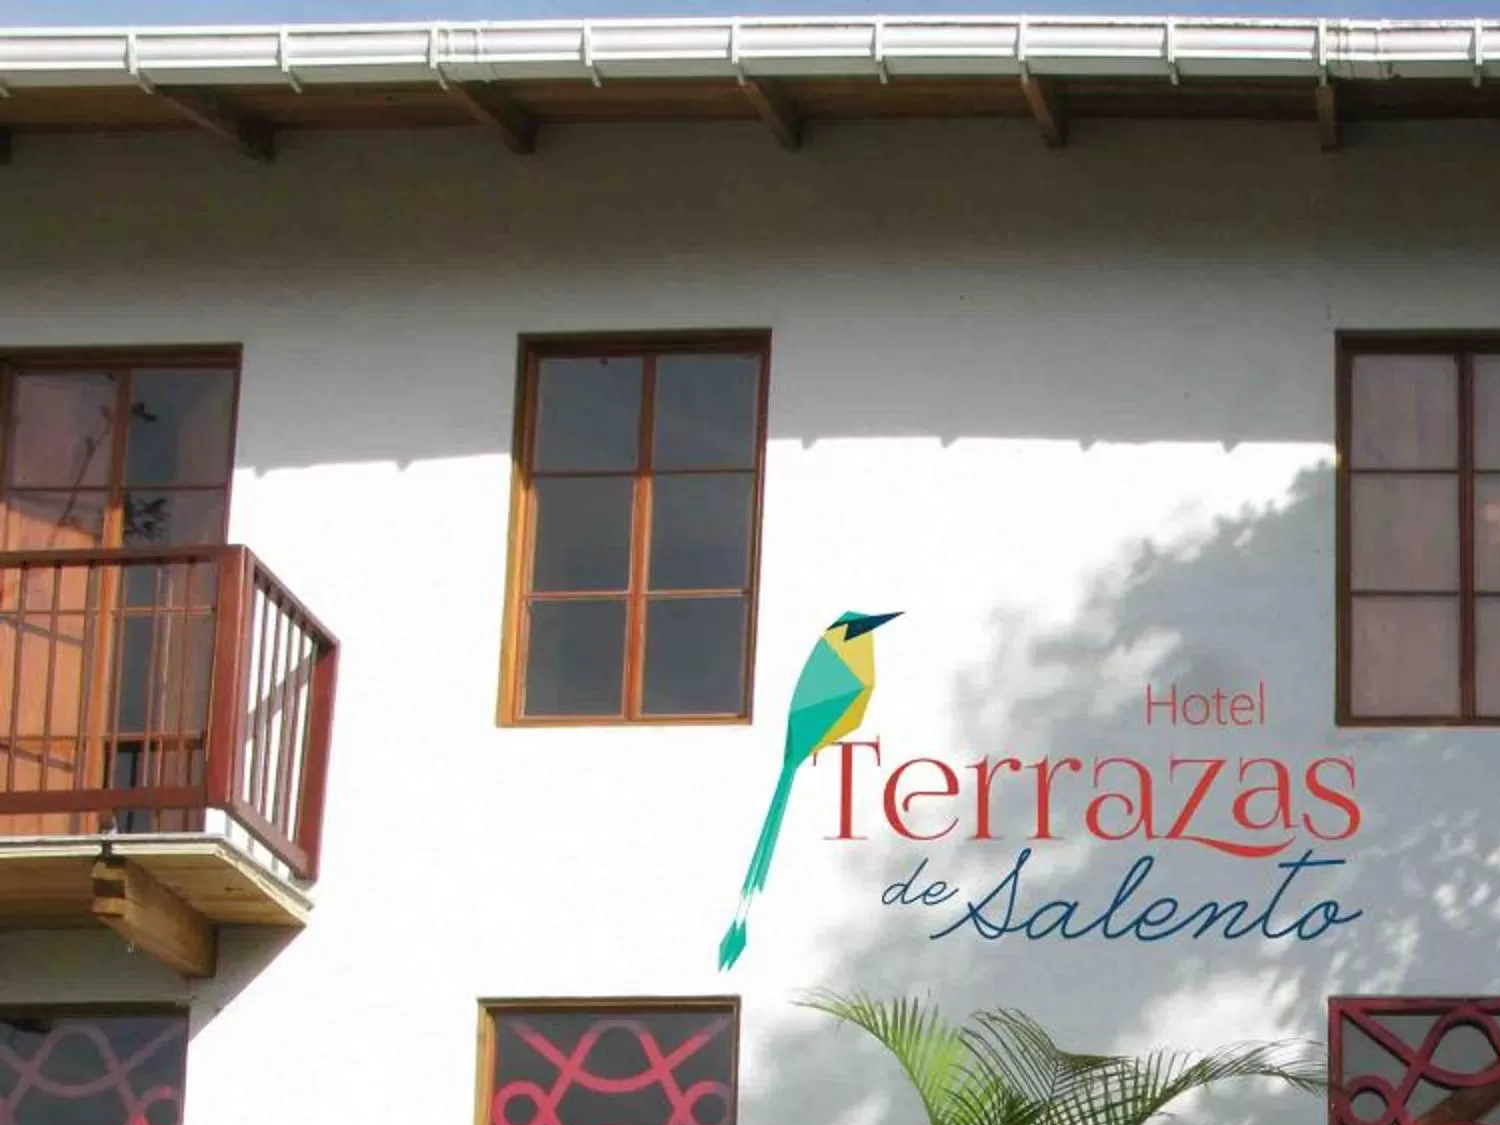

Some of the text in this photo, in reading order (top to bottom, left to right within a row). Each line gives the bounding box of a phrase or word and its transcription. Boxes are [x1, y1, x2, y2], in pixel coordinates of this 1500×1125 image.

[1145, 680, 1265, 727] Hotel
[813, 733, 1362, 858] Terrazas
[881, 847, 1364, 942] de Salento
